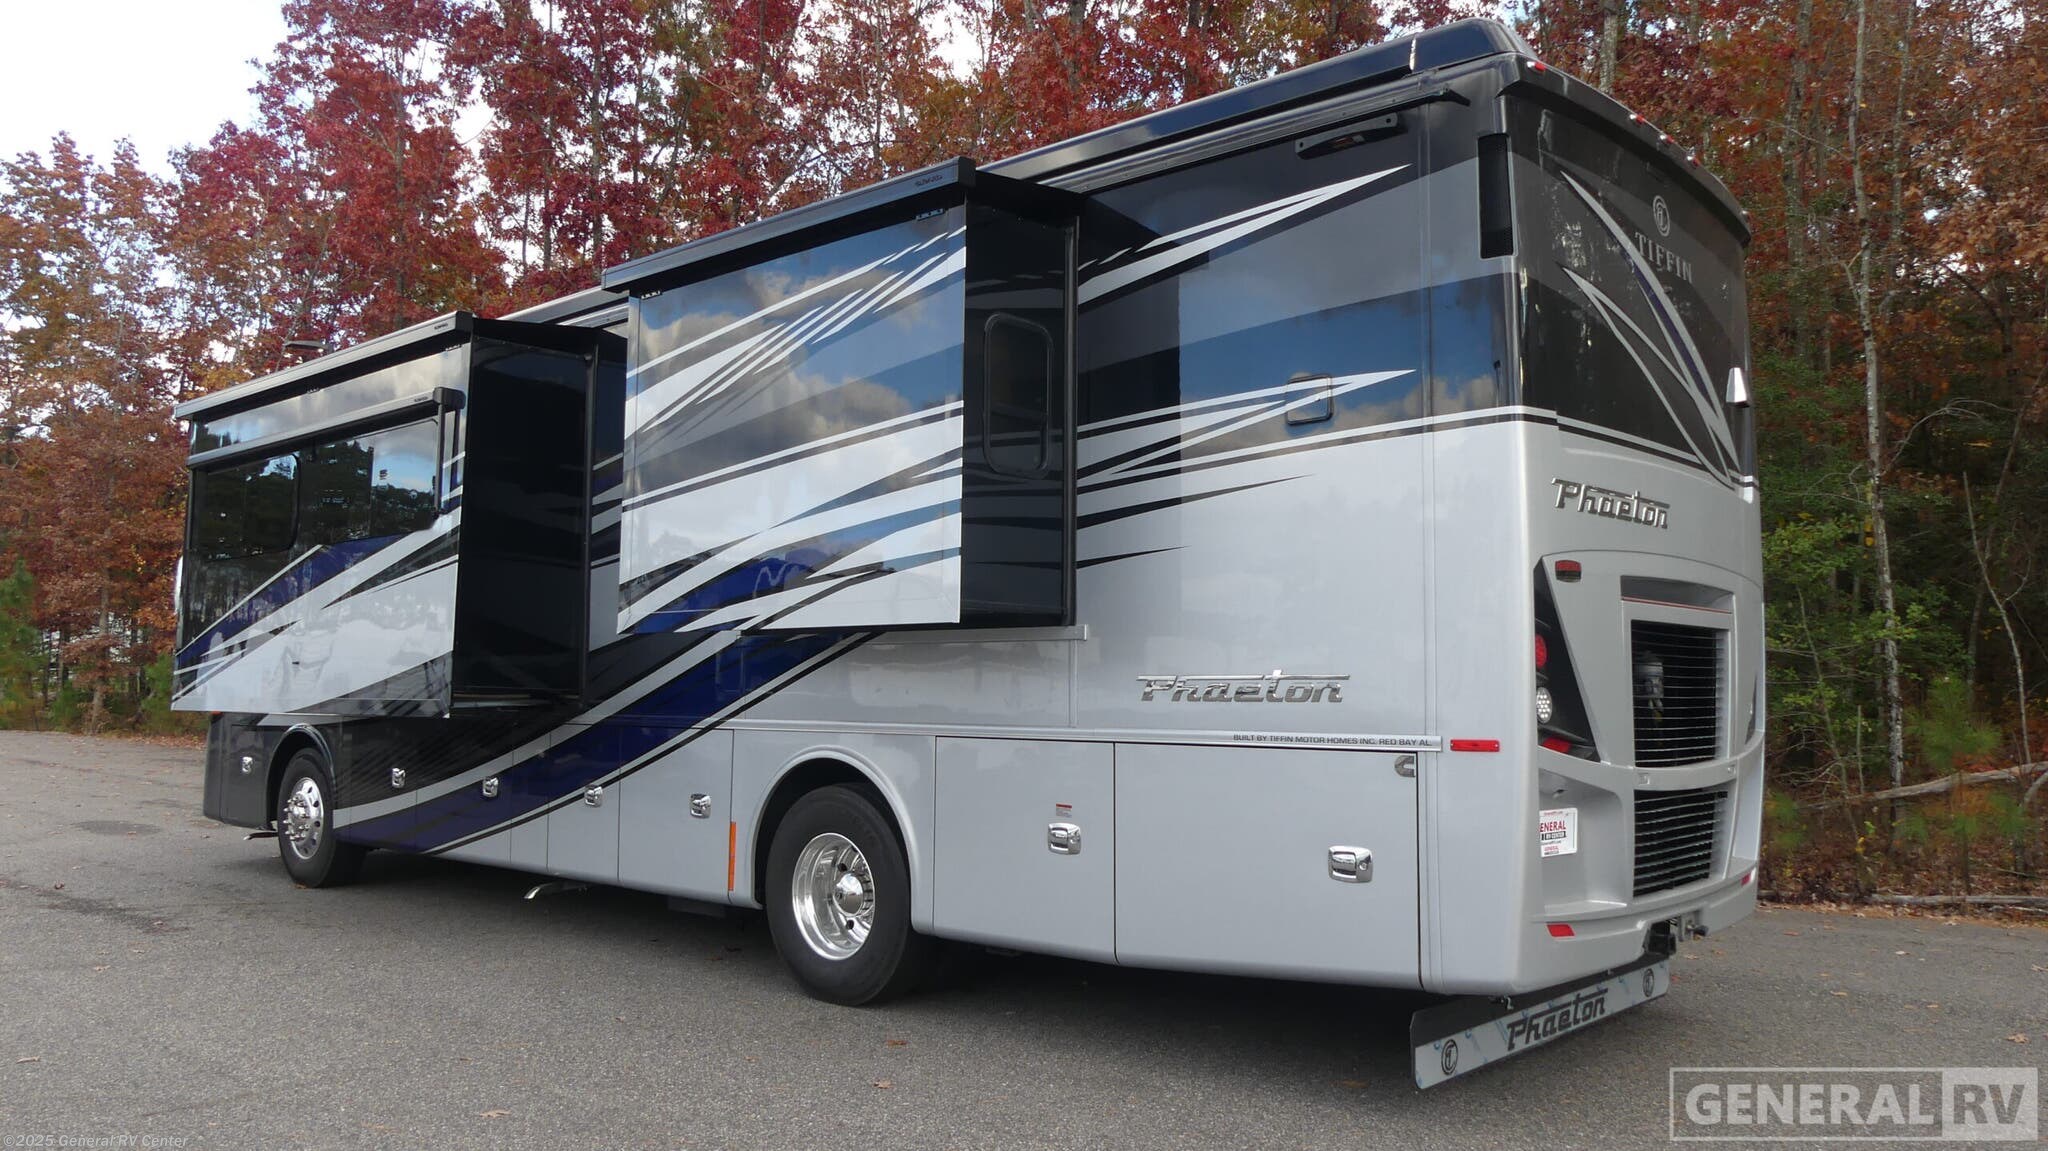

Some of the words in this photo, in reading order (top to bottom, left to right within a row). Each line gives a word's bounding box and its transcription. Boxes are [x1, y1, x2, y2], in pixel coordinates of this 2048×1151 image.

[1635, 231, 1692, 284] TIFFIN
[1551, 477, 1670, 529] Phaeton
[1137, 669, 1351, 703] Phaeton
[1270, 735, 1293, 743] TIFFIN
[1295, 736, 1325, 744] MOTOR
[1327, 737, 1358, 745] HOMES
[1539, 821, 1566, 833] ENERAL
[1507, 988, 1609, 1051] Phaeton
